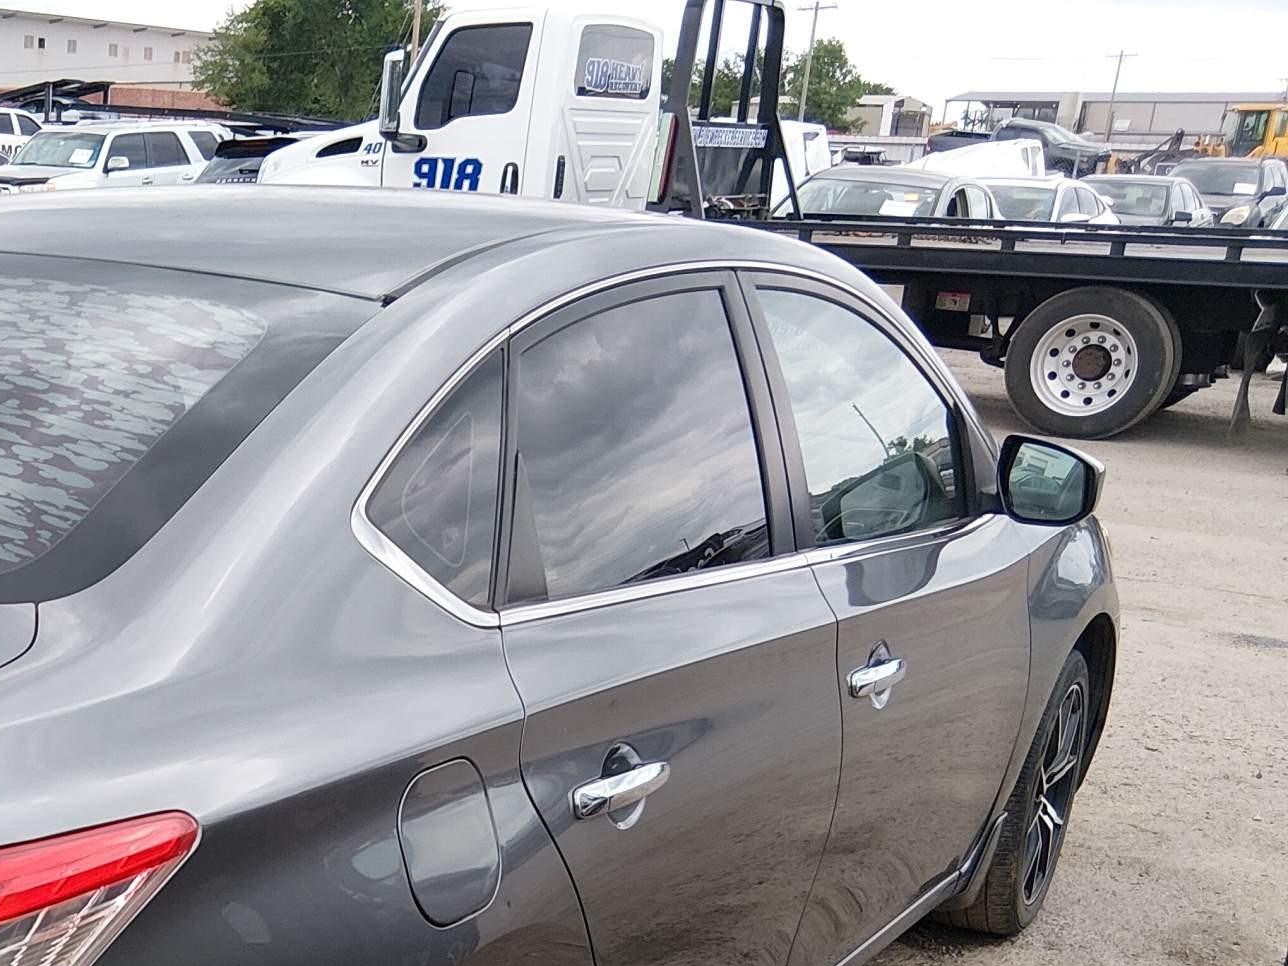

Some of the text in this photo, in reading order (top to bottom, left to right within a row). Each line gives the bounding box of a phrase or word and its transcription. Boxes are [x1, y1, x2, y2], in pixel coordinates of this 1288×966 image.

[586, 59, 609, 90] 918
[363, 142, 383, 154] 40
[413, 157, 483, 192] 918
